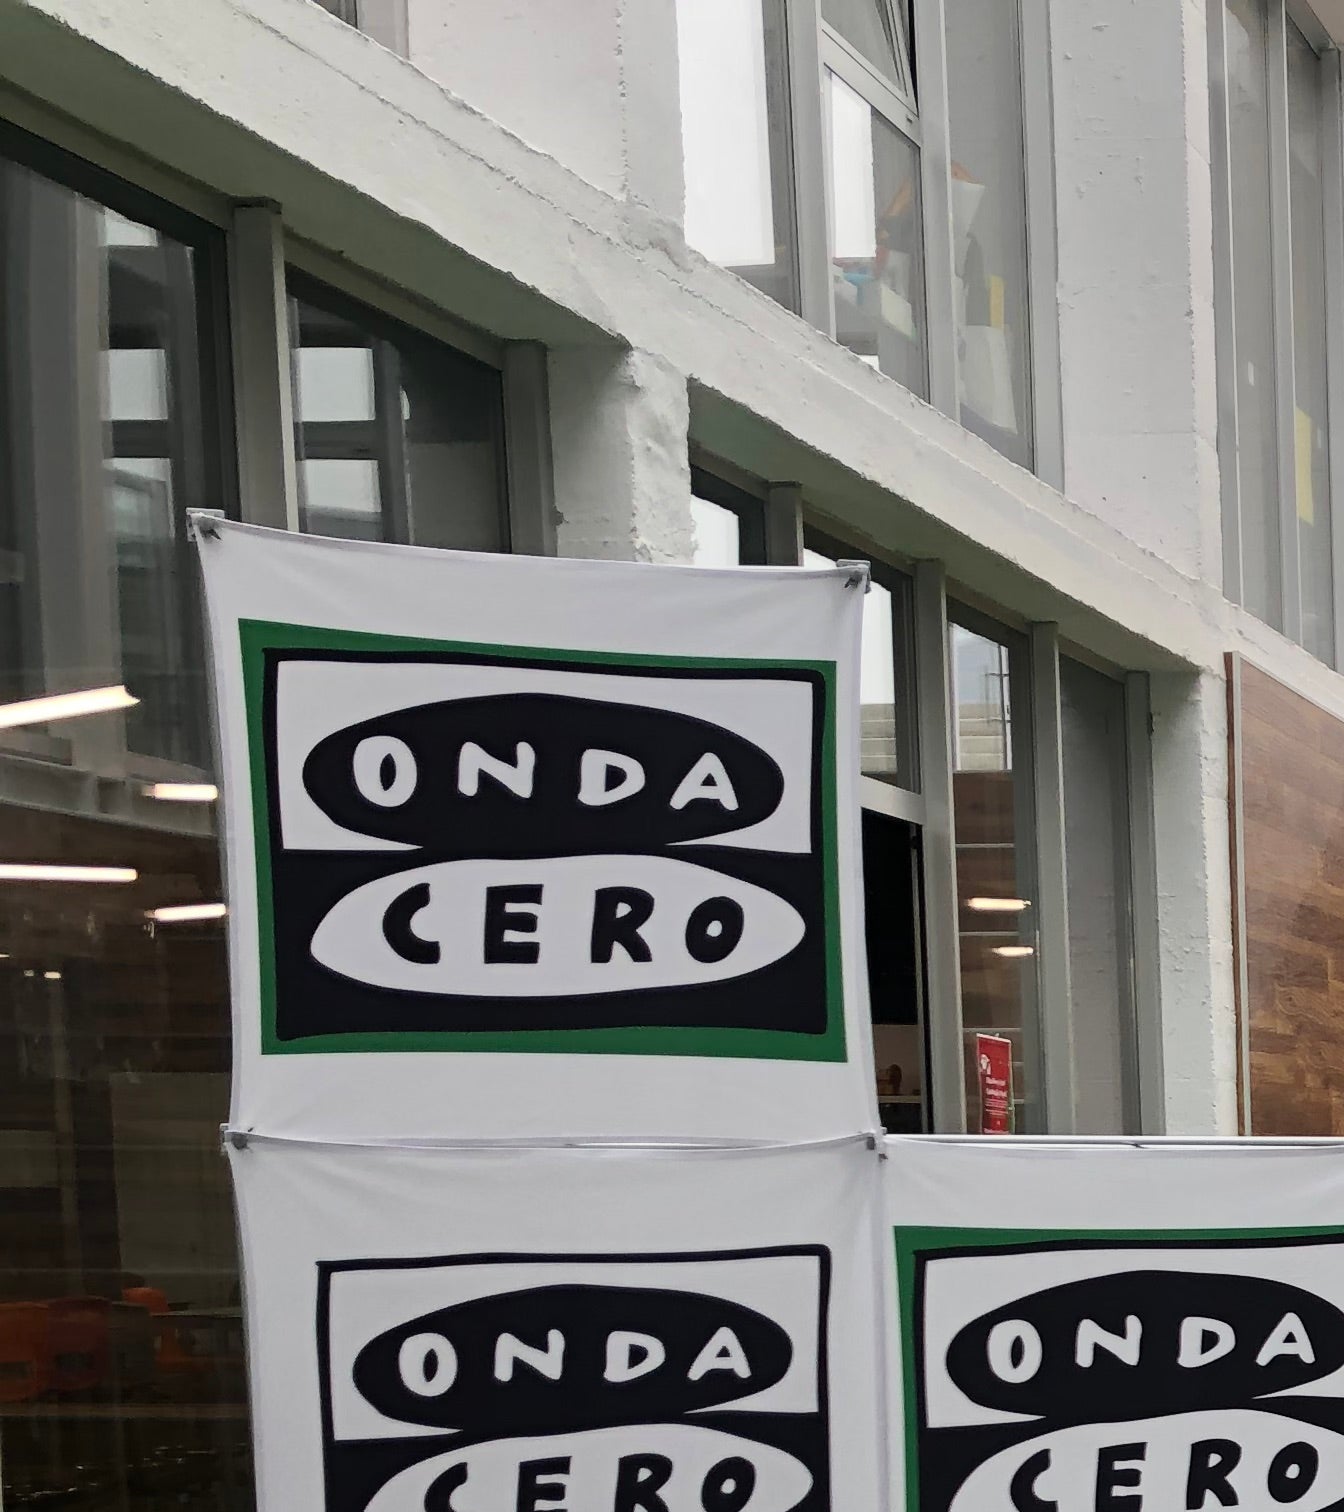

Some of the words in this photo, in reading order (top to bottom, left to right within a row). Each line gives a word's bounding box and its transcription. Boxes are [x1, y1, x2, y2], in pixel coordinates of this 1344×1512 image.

[352, 735, 739, 811] ONDA
[381, 882, 745, 965] CERO
[398, 1326, 753, 1398] ONDA
[986, 1311, 1316, 1384] ONDA
